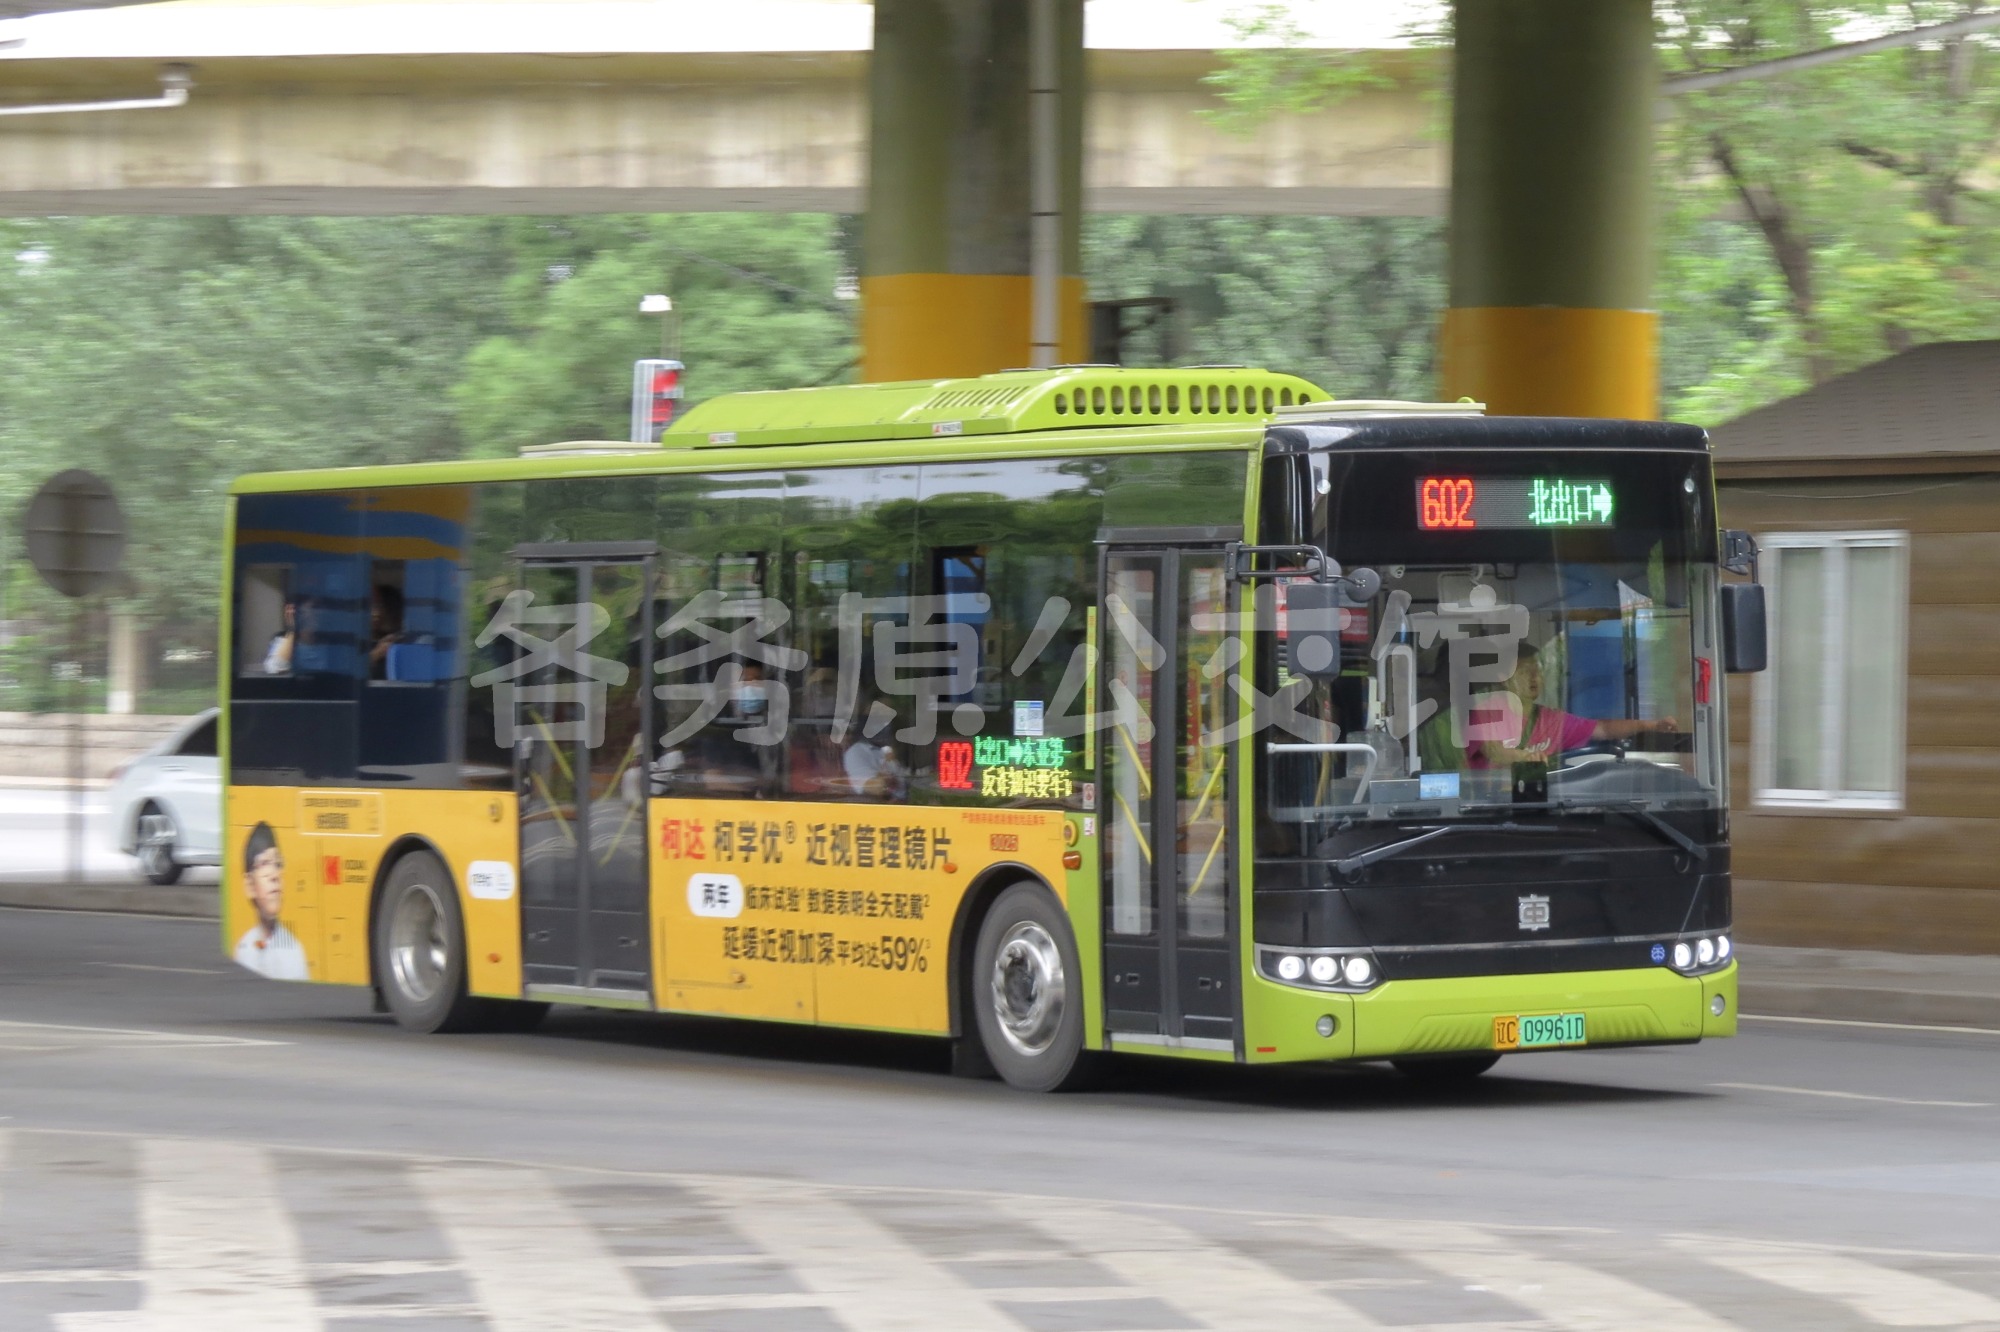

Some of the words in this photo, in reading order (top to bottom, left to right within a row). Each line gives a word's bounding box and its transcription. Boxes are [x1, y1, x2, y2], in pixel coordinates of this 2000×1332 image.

[1422, 479, 1476, 528] 602
[1528, 479, 1593, 525] 北出口
[661, 817, 706, 860] 柯达
[806, 823, 952, 871] 近视管理镜片
